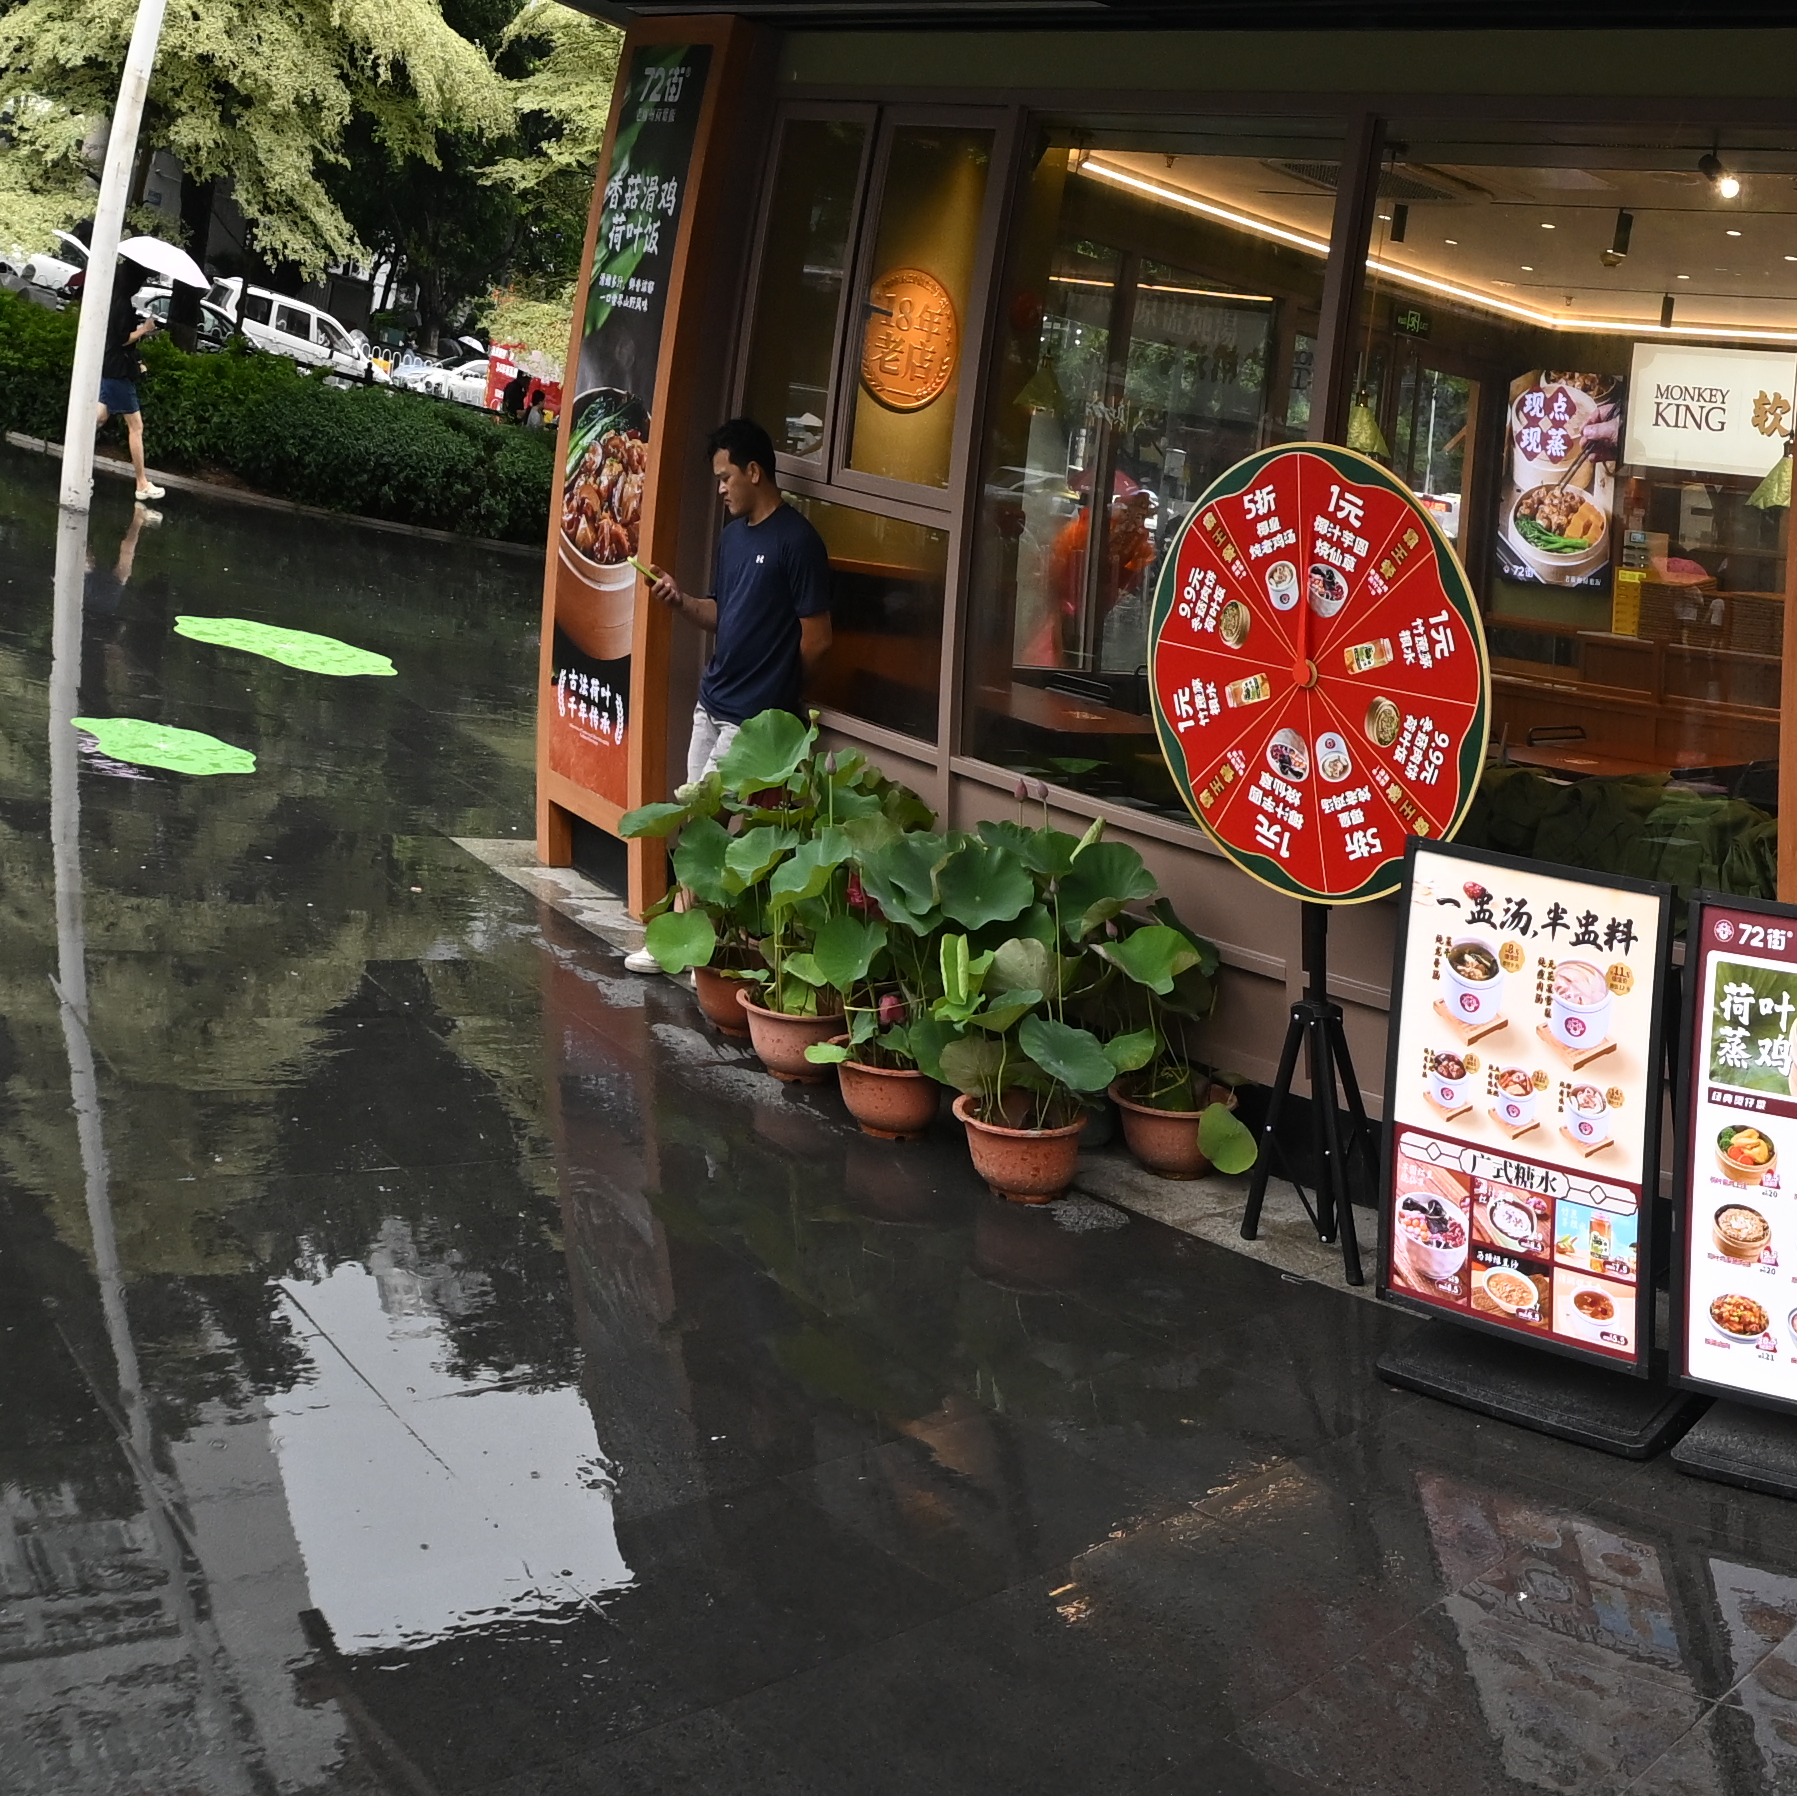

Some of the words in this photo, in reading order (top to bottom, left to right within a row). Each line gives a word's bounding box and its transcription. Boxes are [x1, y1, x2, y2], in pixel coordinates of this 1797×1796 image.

[606, 174, 678, 217] 香菇滑鸡
[609, 213, 660, 255] 荷叶饭
[880, 293, 944, 342] 18年
[871, 330, 937, 384] 老店
[1523, 391, 1571, 422] 现点
[1654, 383, 1730, 405] MONKEY
[1751, 390, 1792, 438] 软
[1652, 403, 1727, 432] KING
[1519, 426, 1568, 457] 现蒸
[1242, 483, 1277, 521] 5折
[1327, 484, 1366, 529] 1元
[1313, 540, 1358, 574] 烧仙草
[1178, 566, 1204, 620] 9.9元
[1428, 608, 1456, 660] 1元
[1172, 684, 1194, 735] 1元
[1423, 730, 1452, 787] 9.9元
[1254, 814, 1293, 860] 1元
[1345, 826, 1384, 862] 5折
[1721, 981, 1796, 1033] 荷叶
[1717, 1026, 1795, 1078] 蒸鸡
[1470, 1153, 1558, 1194] 广式糖水
